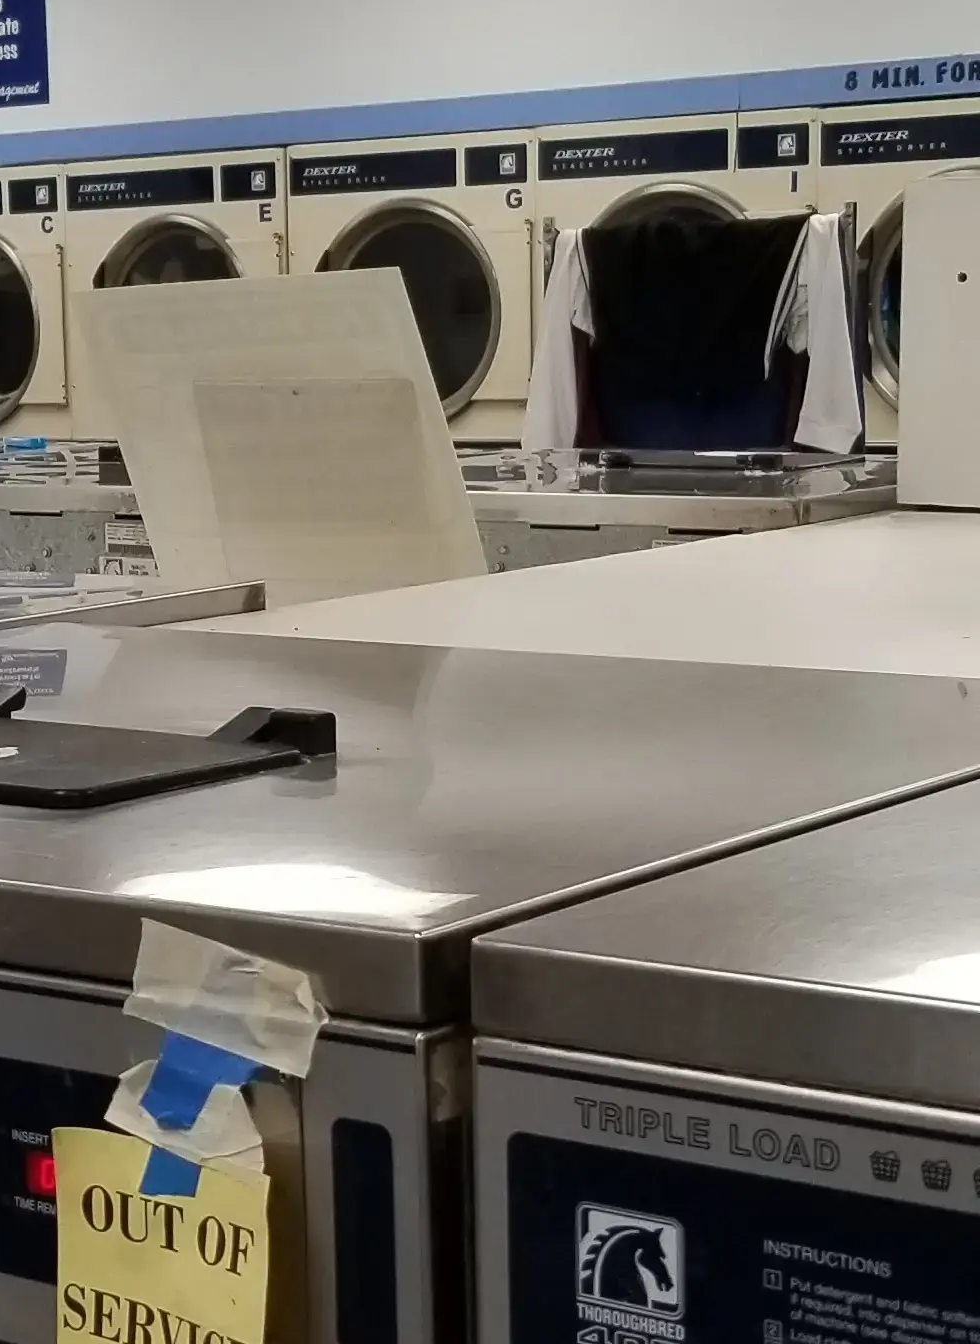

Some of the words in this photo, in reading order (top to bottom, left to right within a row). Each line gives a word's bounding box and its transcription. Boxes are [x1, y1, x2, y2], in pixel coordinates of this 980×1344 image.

[844, 70, 858, 91] 8
[872, 65, 925, 89] MIN.
[936, 60, 980, 83] FOR
[839, 129, 910, 144] DEXTER
[554, 146, 616, 160] DEXTER
[302, 165, 358, 177] DEXTER
[78, 182, 126, 193] DEXTER
[506, 189, 523, 210] G
[258, 202, 273, 223] E
[40, 215, 54, 235] C
[12, 1129, 49, 1146] INSERT
[574, 1096, 711, 1150] TRIPLE
[729, 1124, 841, 1172] LOAD
[14, 1196, 35, 1211] TIME
[82, 1184, 184, 1252] OUT
[198, 1215, 254, 1276] OF
[763, 1239, 892, 1278] INSTRUCTIONS
[577, 1303, 685, 1340] THOROUGHBRED
